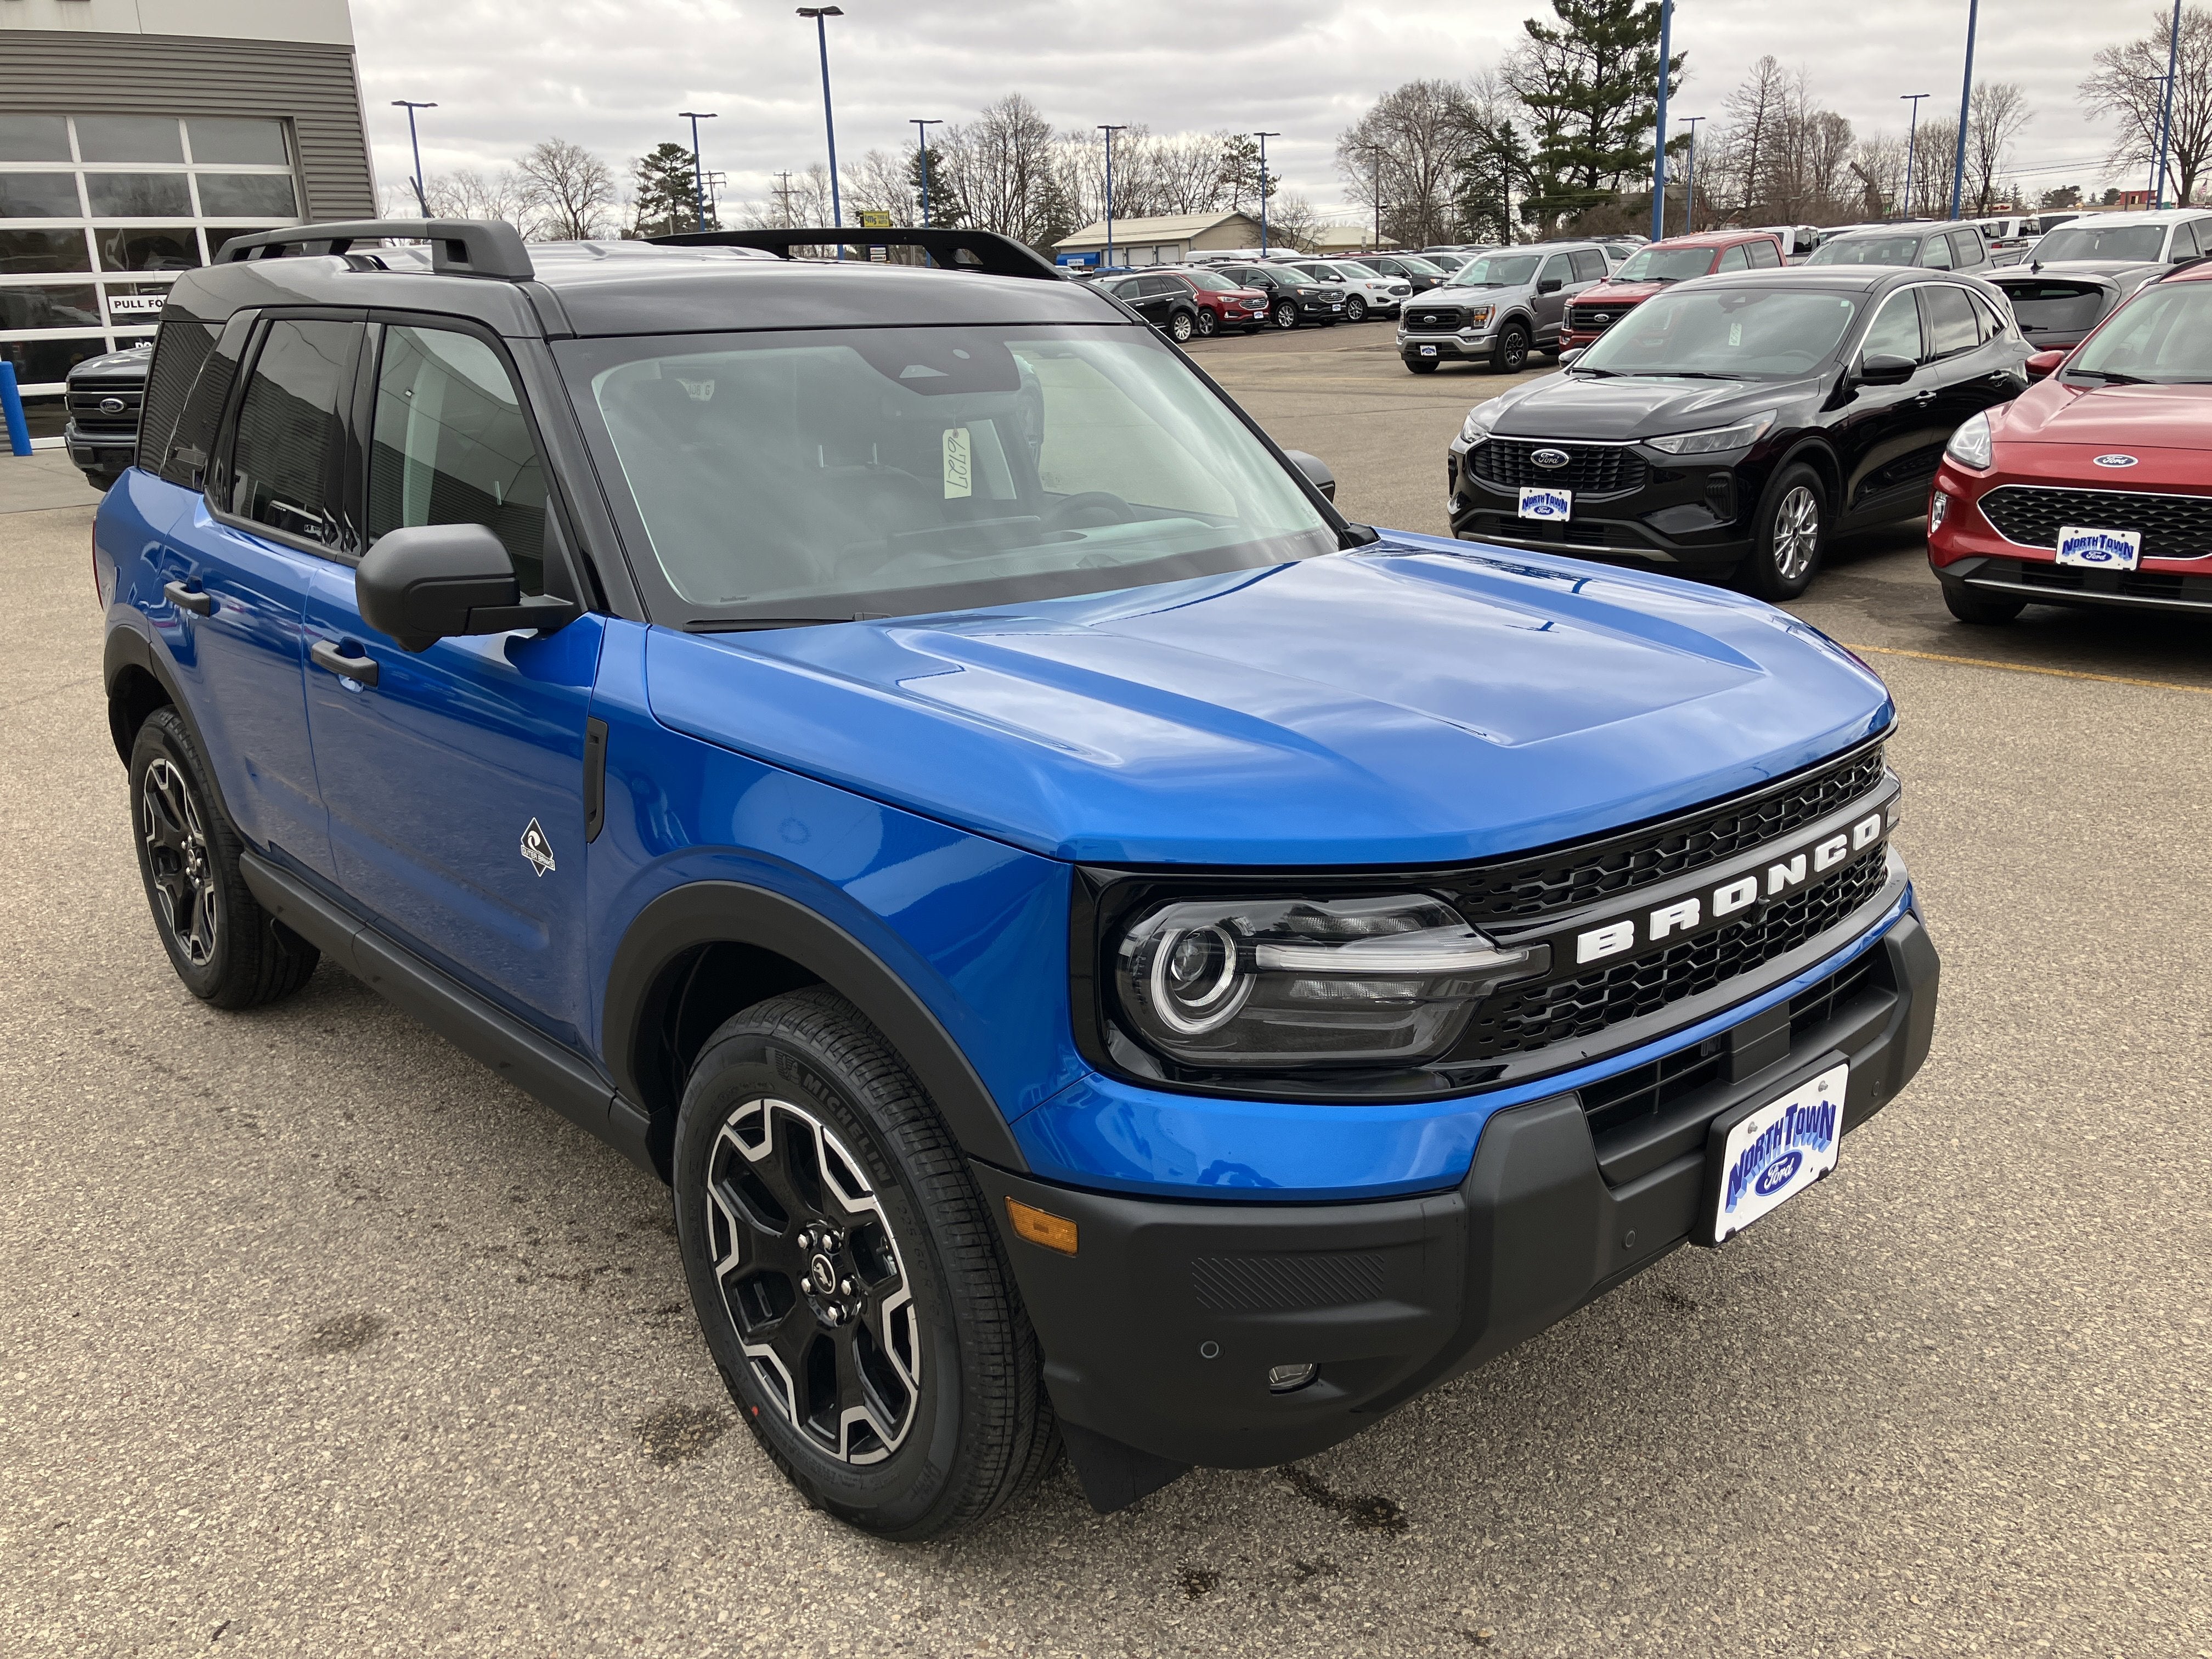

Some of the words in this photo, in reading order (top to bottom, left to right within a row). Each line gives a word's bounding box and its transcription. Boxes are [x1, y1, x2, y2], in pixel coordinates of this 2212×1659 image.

[114, 300, 144, 308] PULL
[148, 300, 165, 308] FO
[946, 436, 968, 489] 6727
[1538, 452, 1559, 464] Ford
[2102, 456, 2128, 464] Ford
[1522, 495, 1545, 512] NORTH
[1545, 493, 1568, 514] TOWN
[2062, 536, 2098, 557] NORTH
[2099, 534, 2134, 561] TOWN
[2086, 551, 2107, 560] Ford
[522, 848, 538, 860] OUTER
[538, 854, 554, 868] BANKS
[1576, 813, 1881, 964] BRONCO
[803, 1073, 891, 1181] MICHELIN
[1725, 1116, 1785, 1213] NORTH
[1785, 1099, 1837, 1153] TOWN
[1764, 1156, 1795, 1190] Ford
